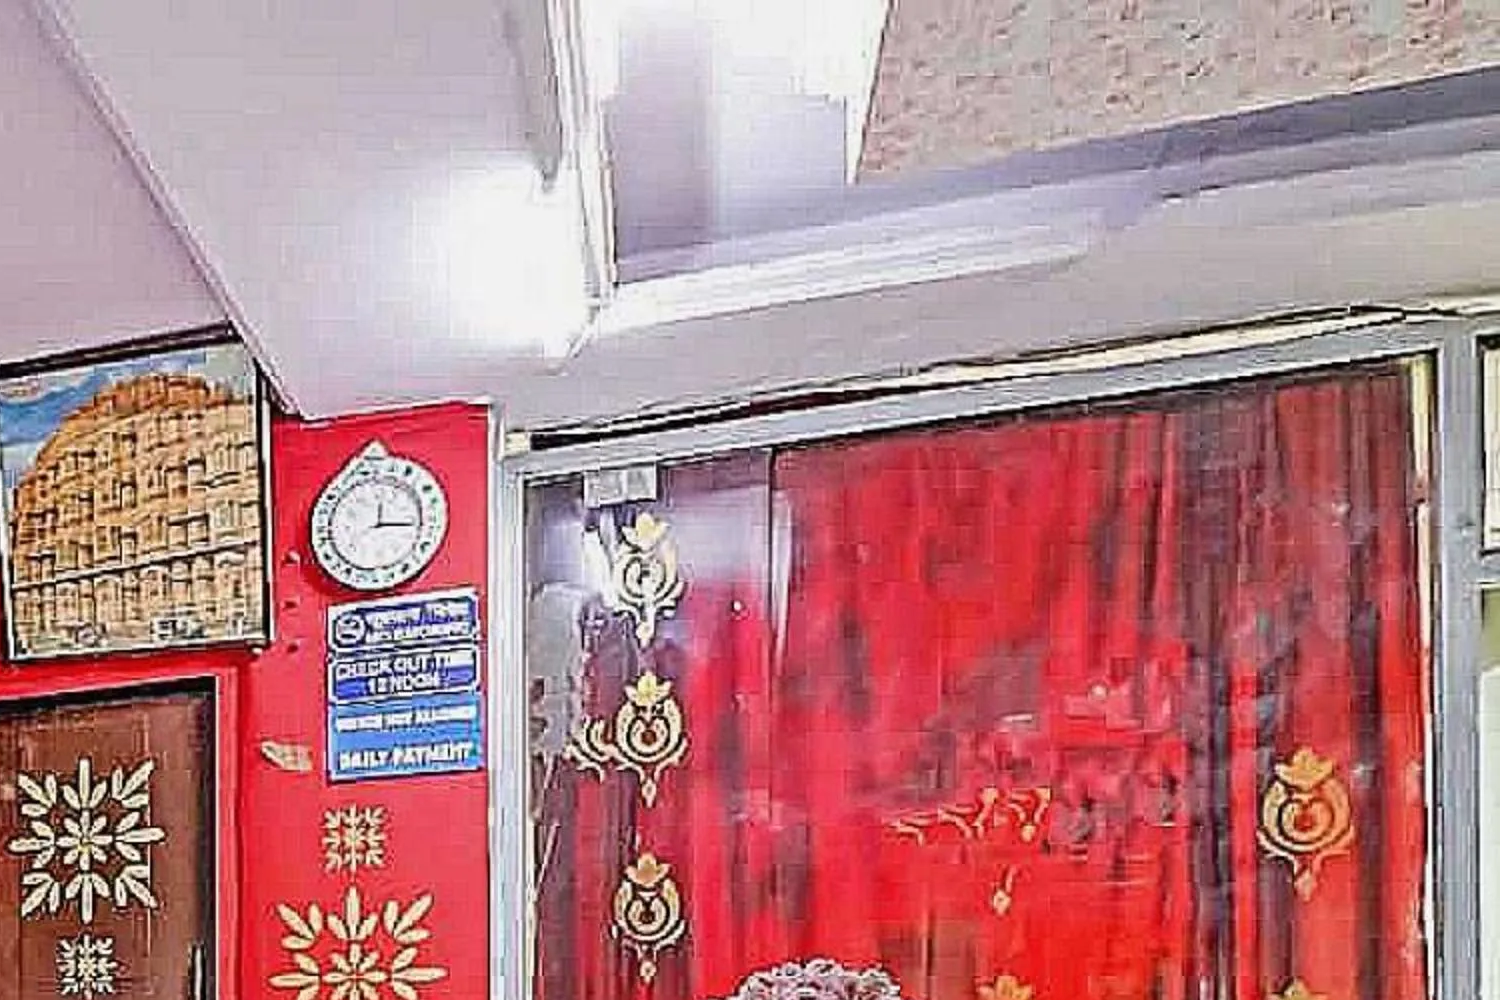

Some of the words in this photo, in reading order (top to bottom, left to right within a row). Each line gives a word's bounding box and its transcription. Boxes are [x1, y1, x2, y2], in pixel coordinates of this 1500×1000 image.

[336, 660, 393, 680] CHECK
[393, 656, 431, 675] OUT
[389, 674, 440, 692] NOON
[338, 749, 391, 771] DAILY
